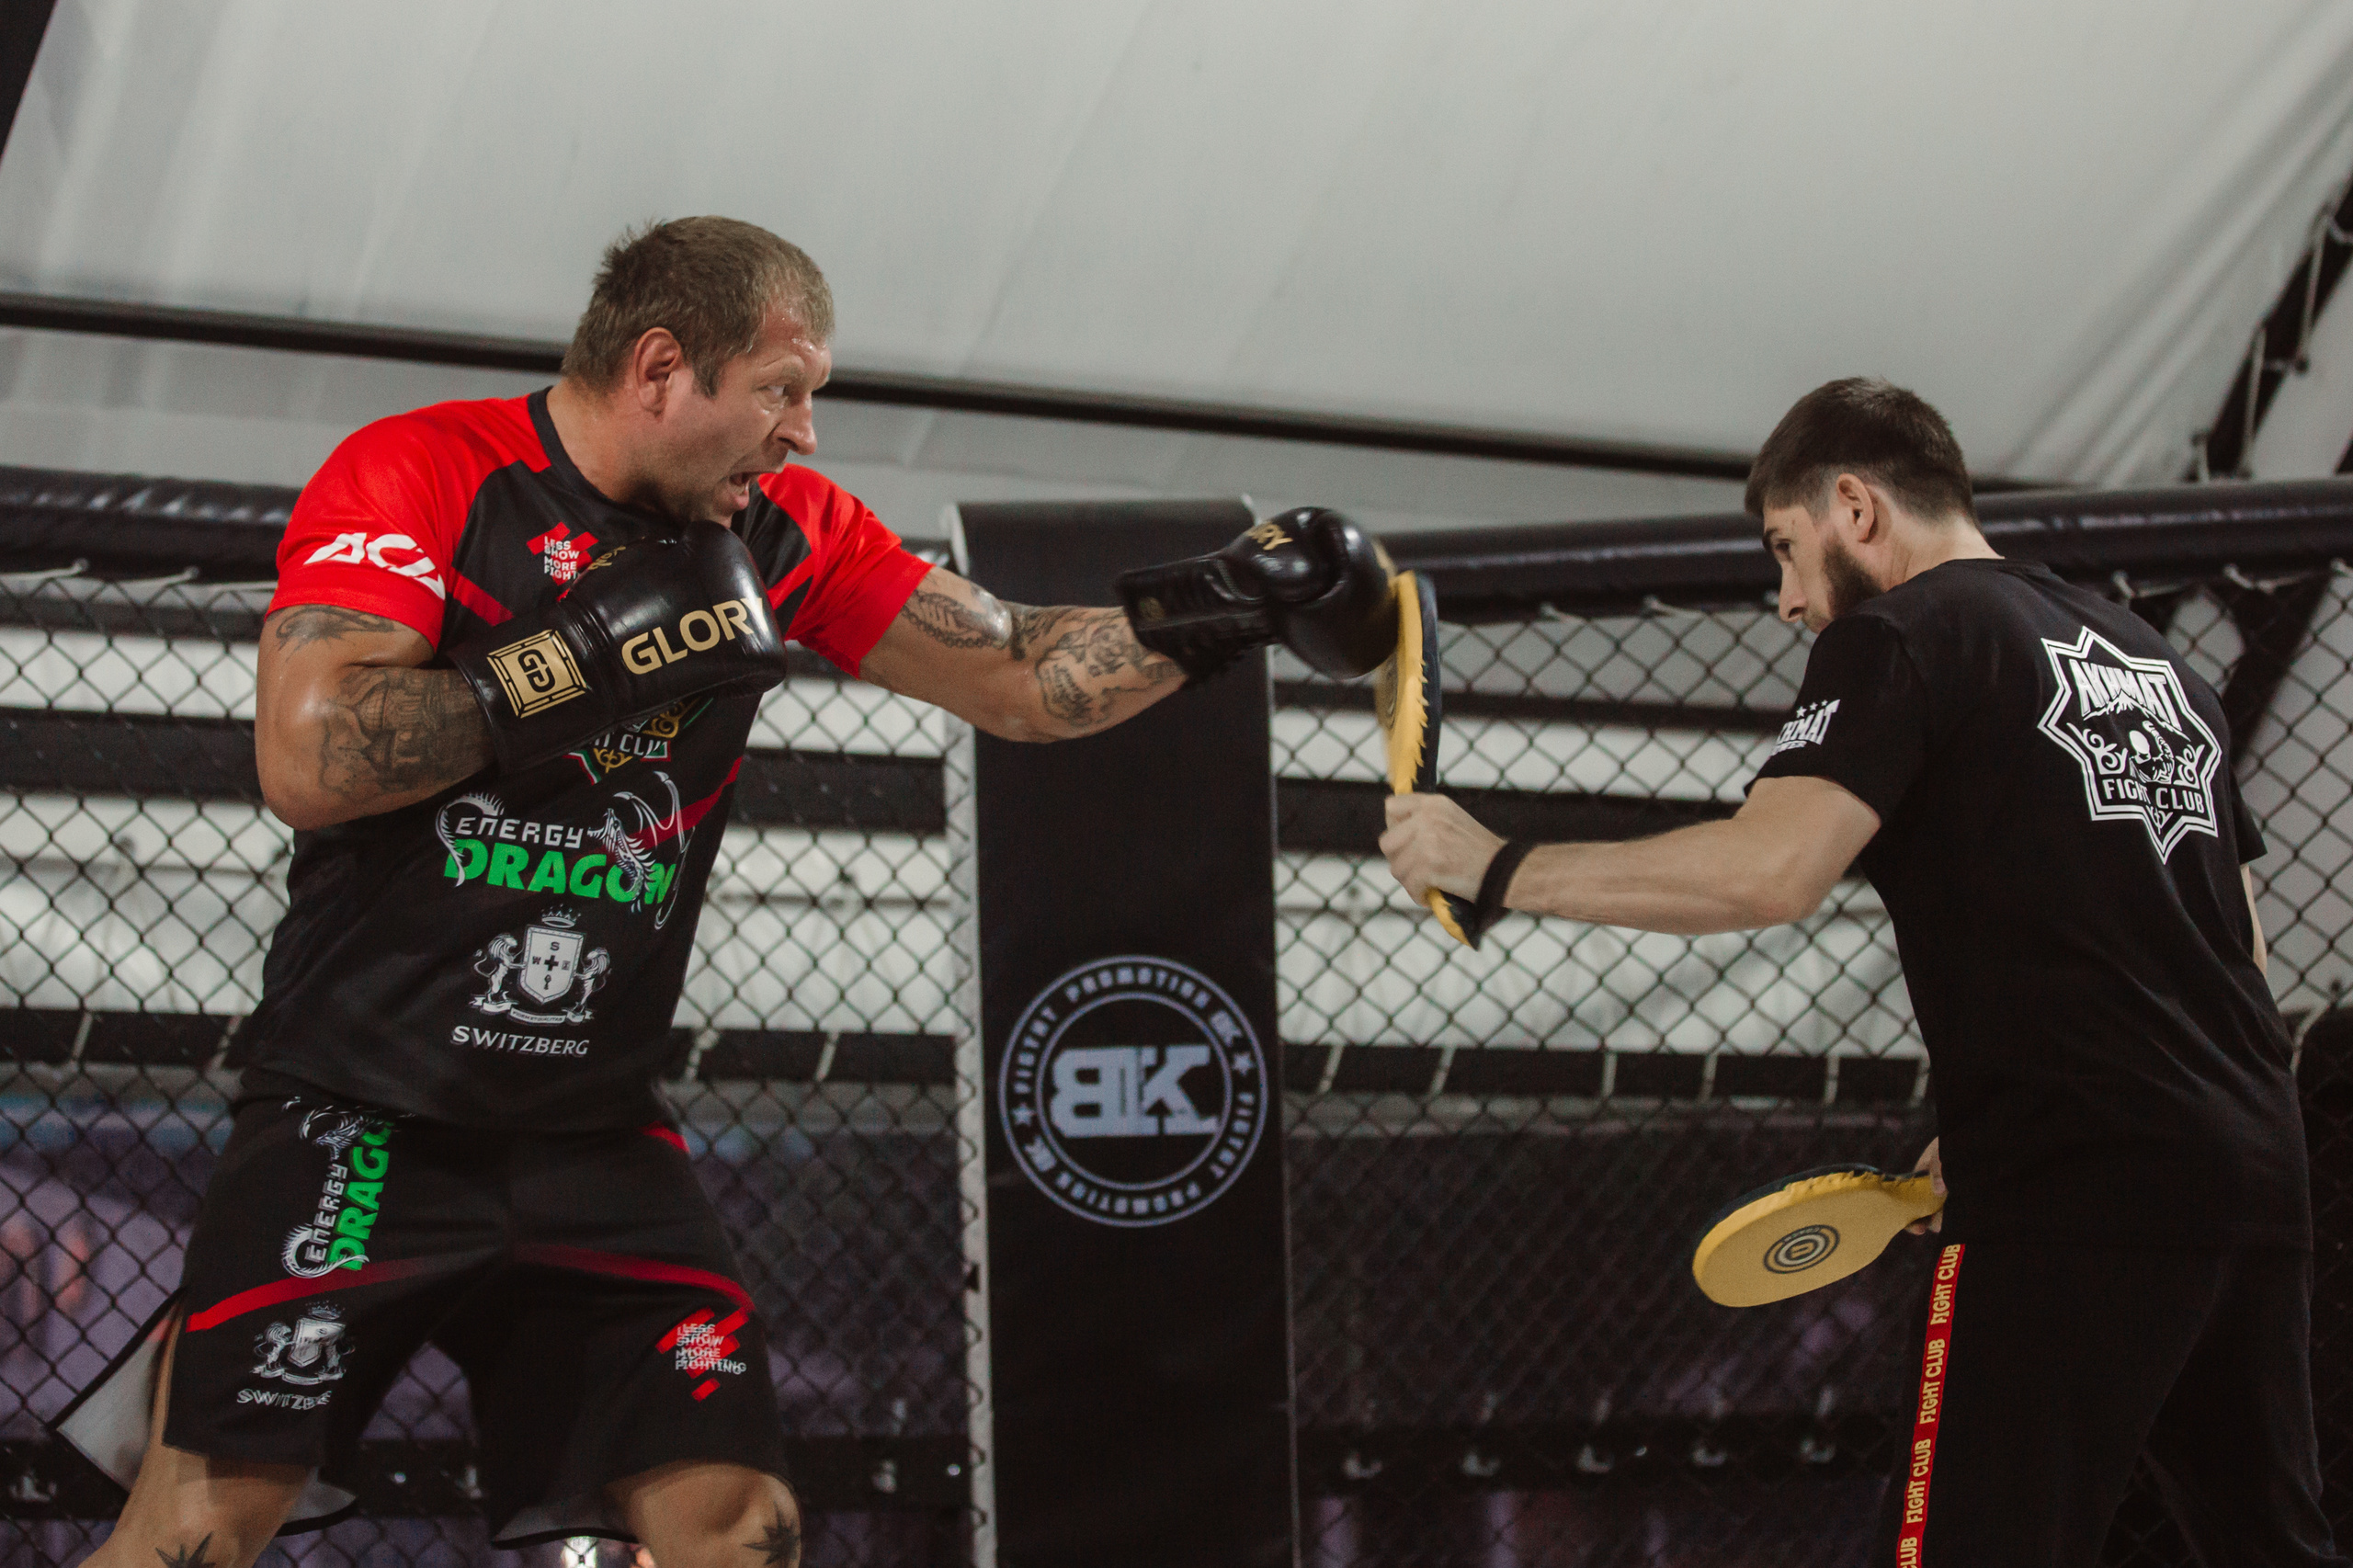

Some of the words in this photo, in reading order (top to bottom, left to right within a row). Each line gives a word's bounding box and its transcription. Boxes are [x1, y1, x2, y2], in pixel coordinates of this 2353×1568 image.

[544, 536, 571, 551] LESS
[544, 545, 580, 560] SHOW
[544, 556, 577, 571] MORE
[544, 565, 581, 581] FIGHT
[621, 597, 764, 676] GLORY
[2069, 658, 2182, 732] AKHMAT
[2102, 778, 2152, 805] FIGHT
[2155, 788, 2205, 813] CLUB
[455, 817, 584, 848] ENERGY
[444, 838, 676, 904] DRAGON
[451, 1026, 590, 1055] SWITZBERG
[304, 1164, 348, 1263] ENERGY
[327, 1121, 393, 1271] DRAGO
[1938, 1244, 1961, 1280] CLUB
[1930, 1284, 1952, 1324] FIGHT
[1925, 1338, 1946, 1378] CLUB
[1919, 1381, 1940, 1425] FIGHT
[1913, 1438, 1931, 1477] CLUB
[1906, 1481, 1927, 1523] FIGHT
